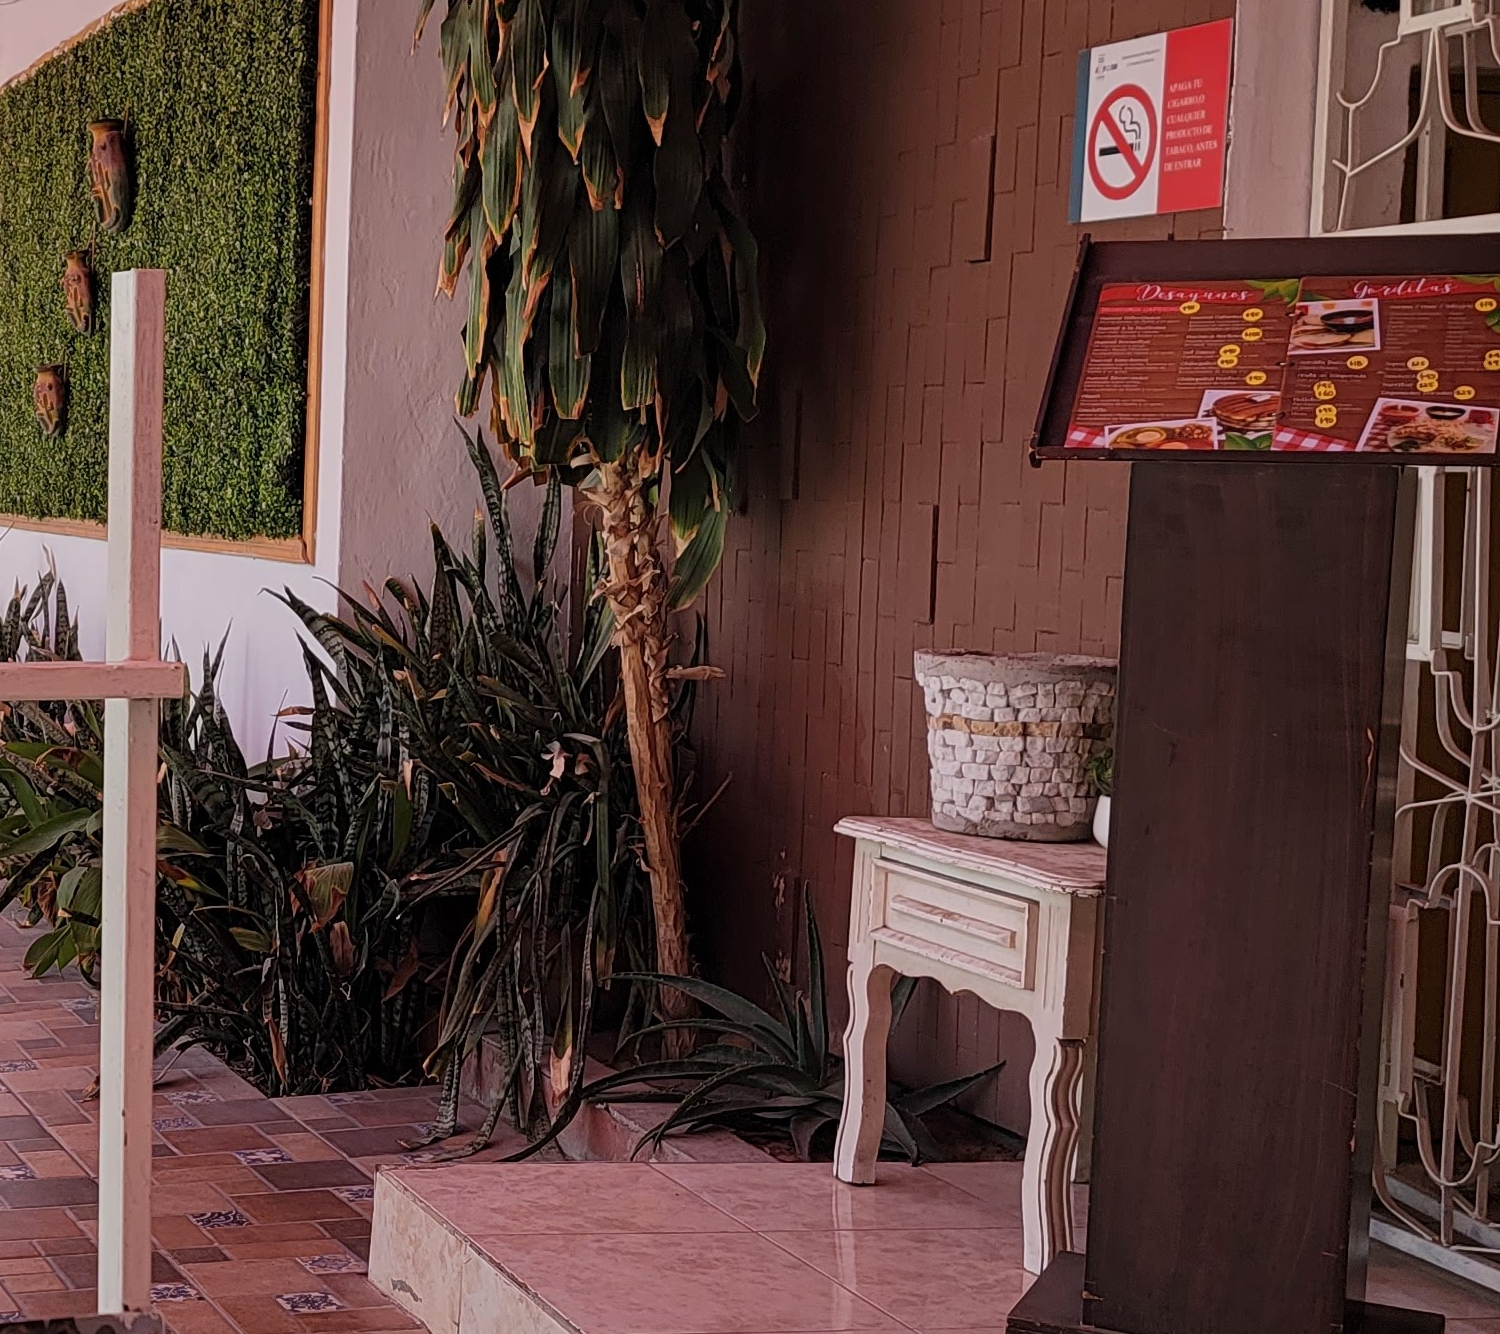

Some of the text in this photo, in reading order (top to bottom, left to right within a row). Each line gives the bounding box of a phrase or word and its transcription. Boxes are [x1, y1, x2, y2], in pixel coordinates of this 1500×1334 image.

[1168, 78, 1203, 93] APAGA TU
[1166, 110, 1206, 125] CUALQUIER
[1165, 125, 1213, 140] PRODUCTO DE
[1195, 140, 1218, 152] ANTES
[1164, 158, 1202, 172] DE ENTRAR
[1136, 284, 1252, 301] Desayunos
[1353, 278, 1458, 298] Gorditas
